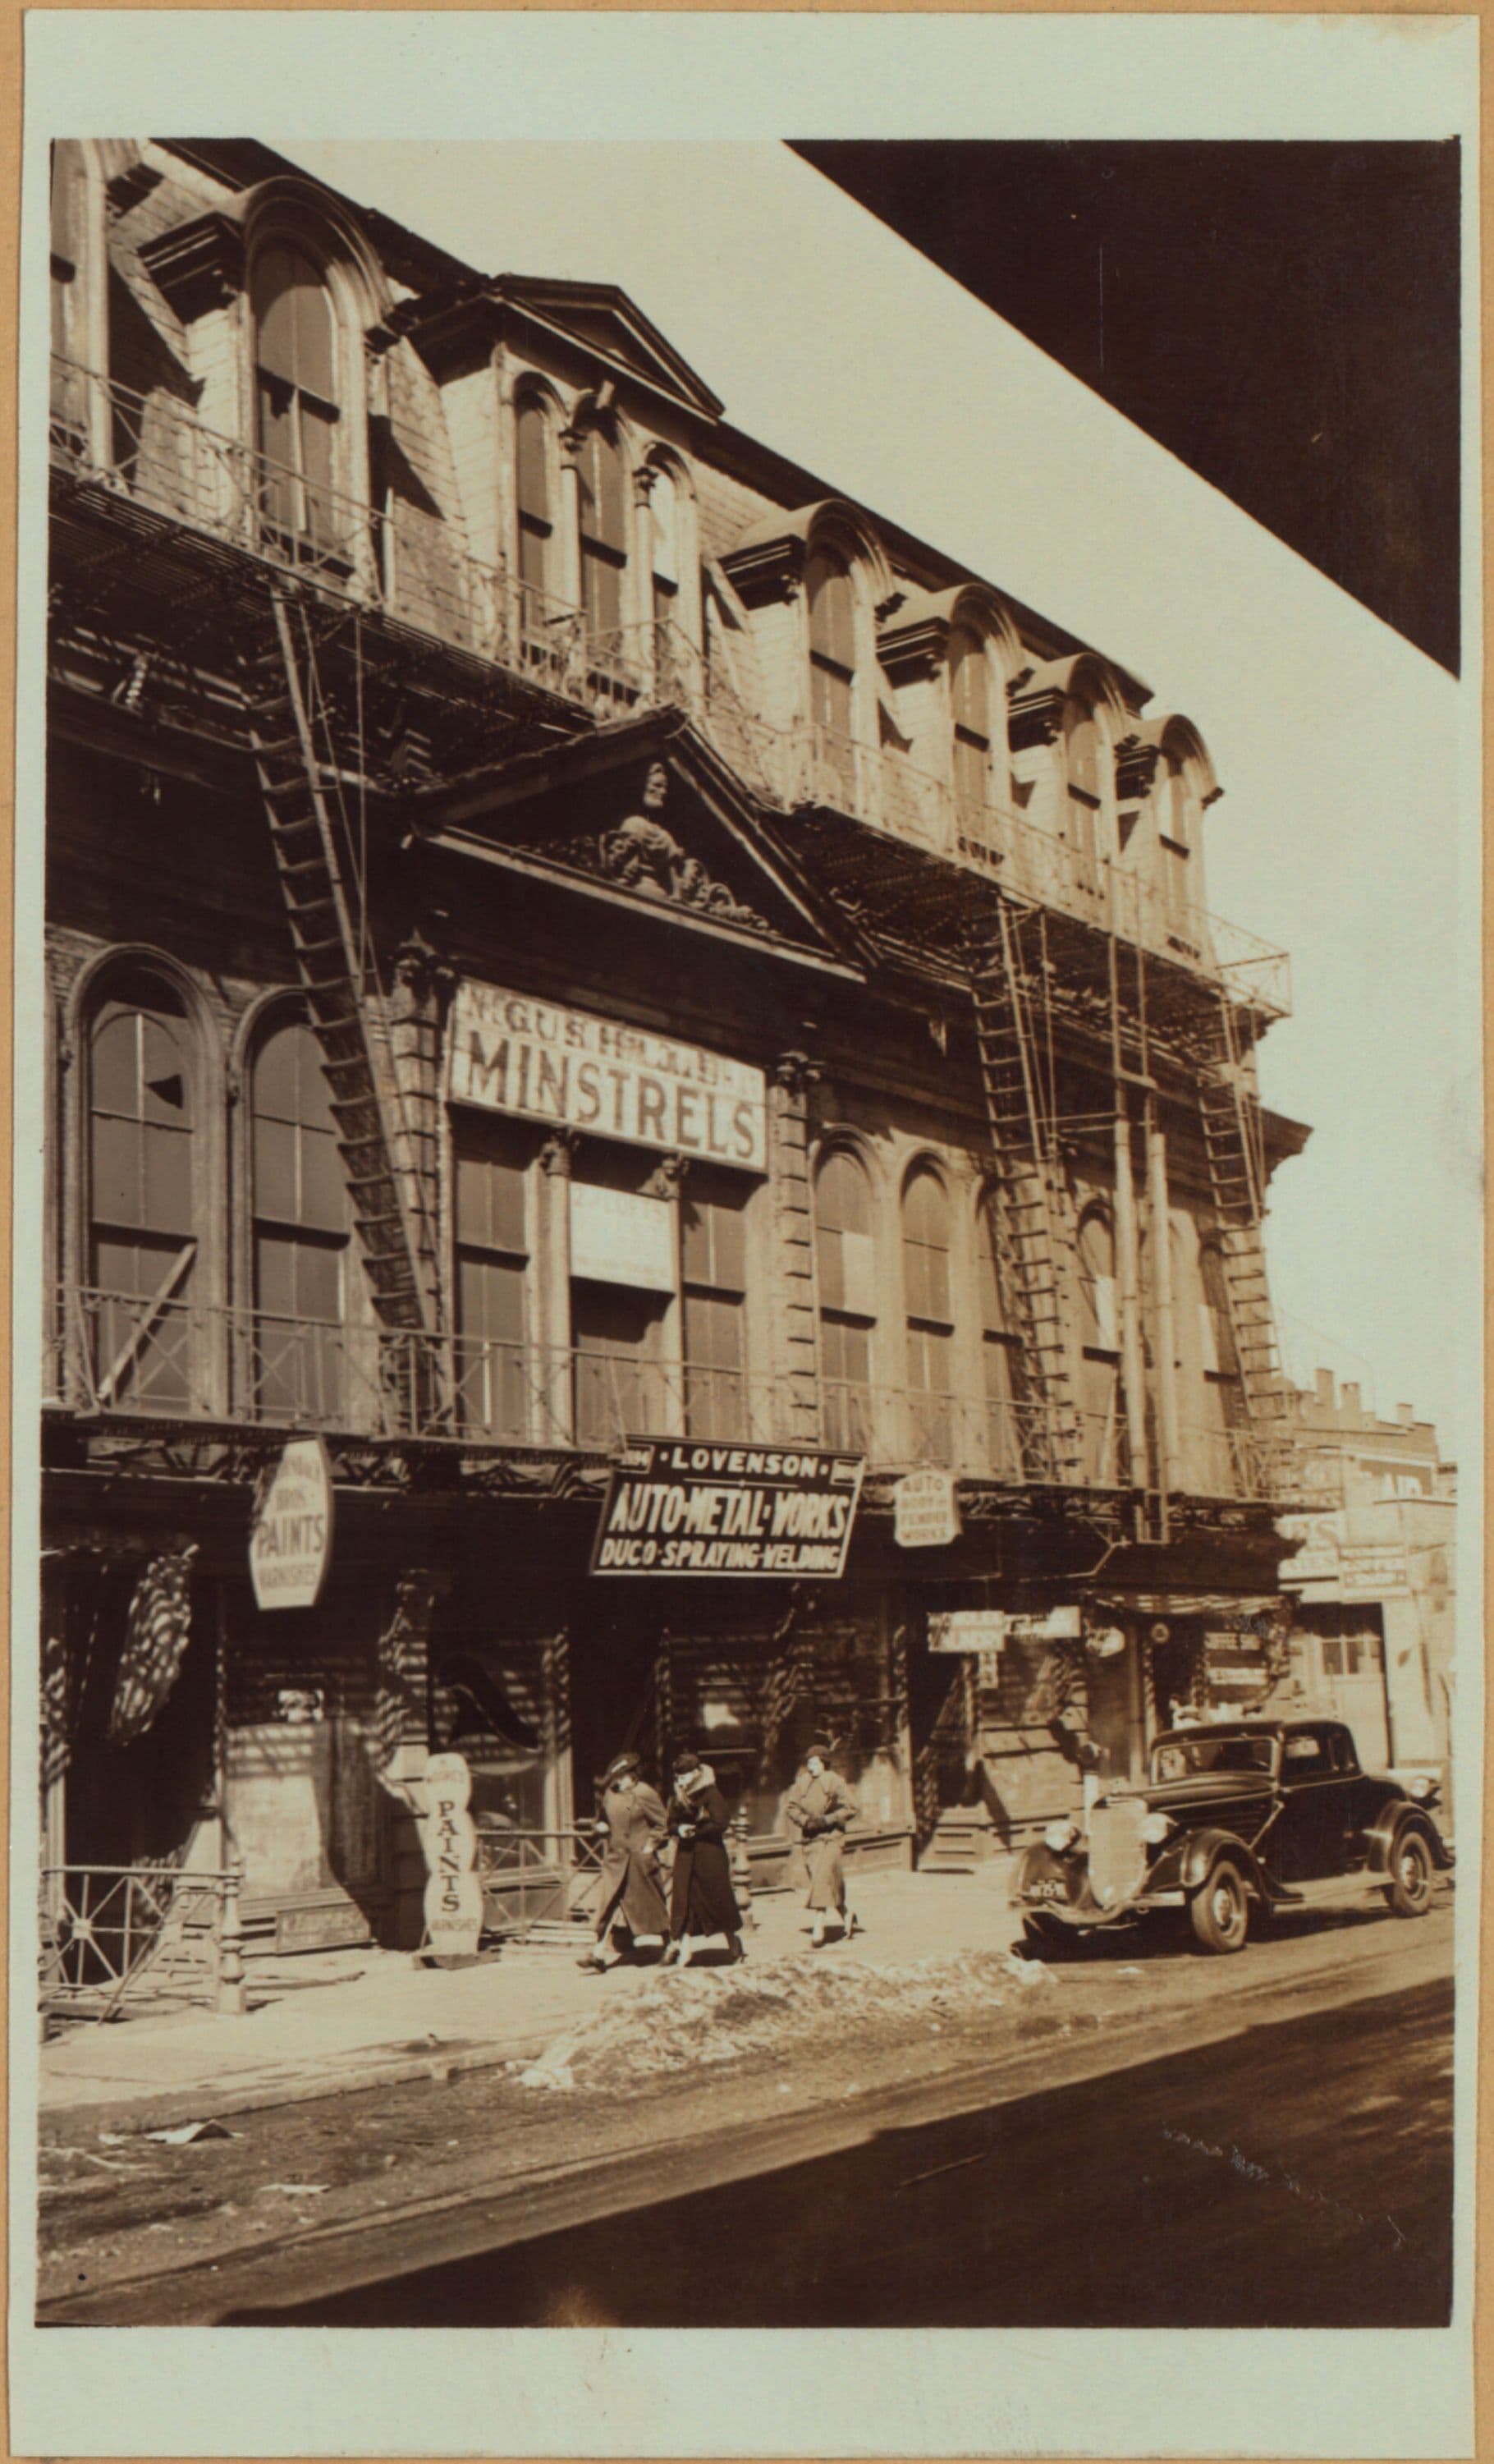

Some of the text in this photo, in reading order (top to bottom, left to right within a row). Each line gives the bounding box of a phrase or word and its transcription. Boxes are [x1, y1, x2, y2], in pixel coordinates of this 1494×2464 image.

[467, 1030, 757, 1159] MINSTRELS
[671, 1446, 820, 1479] LOVENSON
[256, 1513, 324, 1560] PAINTS
[607, 1482, 850, 1539] AUTO METAL WORKS
[599, 1538, 841, 1571] DUCO SPRAYING WELDING
[437, 1801, 461, 1912] PAINTS
